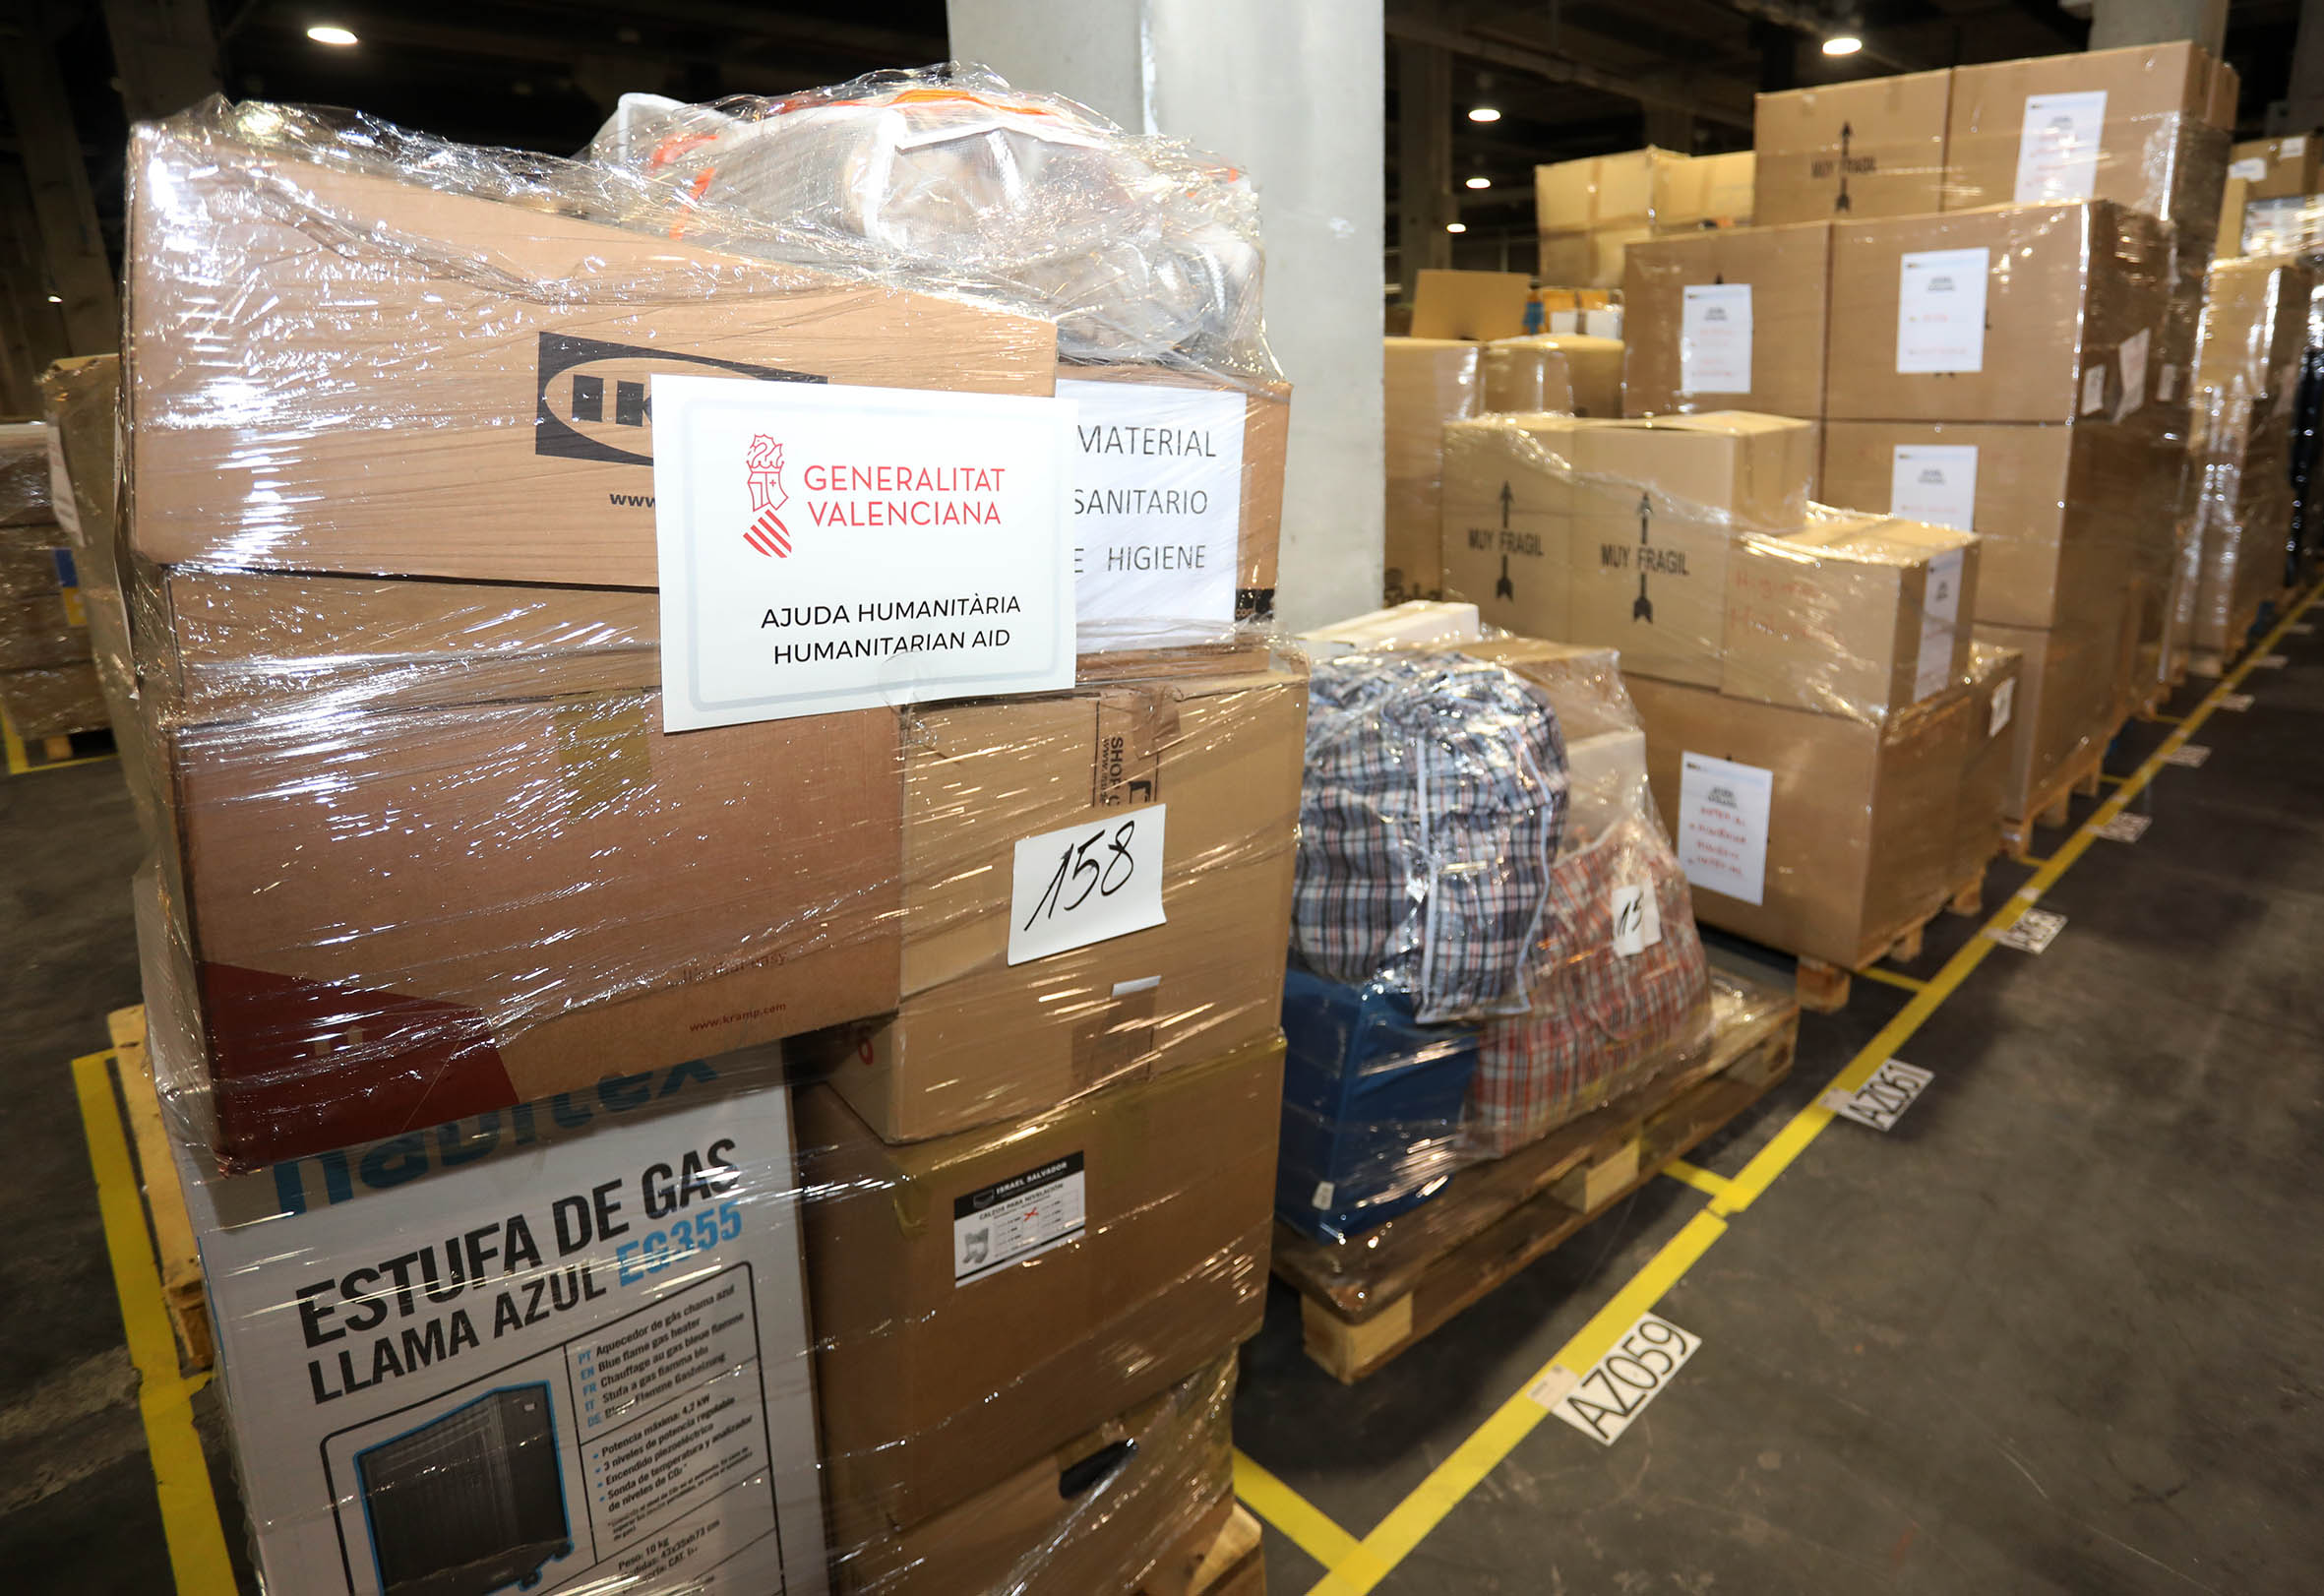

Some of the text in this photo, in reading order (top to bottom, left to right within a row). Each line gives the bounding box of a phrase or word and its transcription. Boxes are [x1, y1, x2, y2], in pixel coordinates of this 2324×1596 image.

[1077, 424, 1216, 457] MATERIAL
[804, 464, 1006, 492] GENERALITAT
[807, 500, 1002, 527] VALENCIANA
[1074, 489, 1208, 514] SANITARIO
[1108, 545, 1206, 571] HIGIENE
[1468, 527, 1545, 557] MUY FRAGIL
[1601, 543, 1690, 576] MUY FRAGIL
[761, 592, 1021, 629] AJUDA HUMANITÀRIA
[773, 629, 1010, 665] HUMANITARIAN AID
[1024, 820, 1135, 931] 158
[690, 1004, 786, 1031] www.kramp.com
[1849, 1064, 1929, 1129] AZ061
[996, 1179, 1024, 1195] ISRAEL
[1026, 1161, 1068, 1182] SALVADOR
[295, 1138, 741, 1348] ESTUFA DE GAS
[307, 1200, 743, 1404] LLAMA AZUL EG355
[595, 1323, 648, 1358] Aquecedor
[650, 1318, 662, 1331] de
[683, 1294, 713, 1316] chama
[598, 1353, 621, 1372] Blue
[622, 1340, 649, 1361] flame
[651, 1332, 669, 1348] gas
[670, 1316, 701, 1338] heater
[600, 1356, 650, 1388] Chauffage
[652, 1351, 664, 1364] au
[666, 1342, 683, 1358] gas
[1565, 1320, 1687, 1440] AZ059
[602, 1382, 628, 1404] Stufa
[631, 1381, 637, 1390] a
[639, 1372, 656, 1387] gas
[601, 1429, 642, 1457] Potencia
[603, 1459, 610, 1471] 3
[612, 1443, 643, 1467] niveles
[645, 1437, 657, 1450] de
[658, 1417, 695, 1444] potencia
[605, 1453, 652, 1486] Encendido
[607, 1477, 636, 1500] Sonda
[638, 1470, 649, 1484] de
[650, 1442, 703, 1477] temperatura
[704, 1440, 710, 1448] y
[608, 1499, 620, 1512] de
[622, 1481, 653, 1505] niveles
[654, 1474, 666, 1488] de
[645, 1544, 656, 1555] 10
